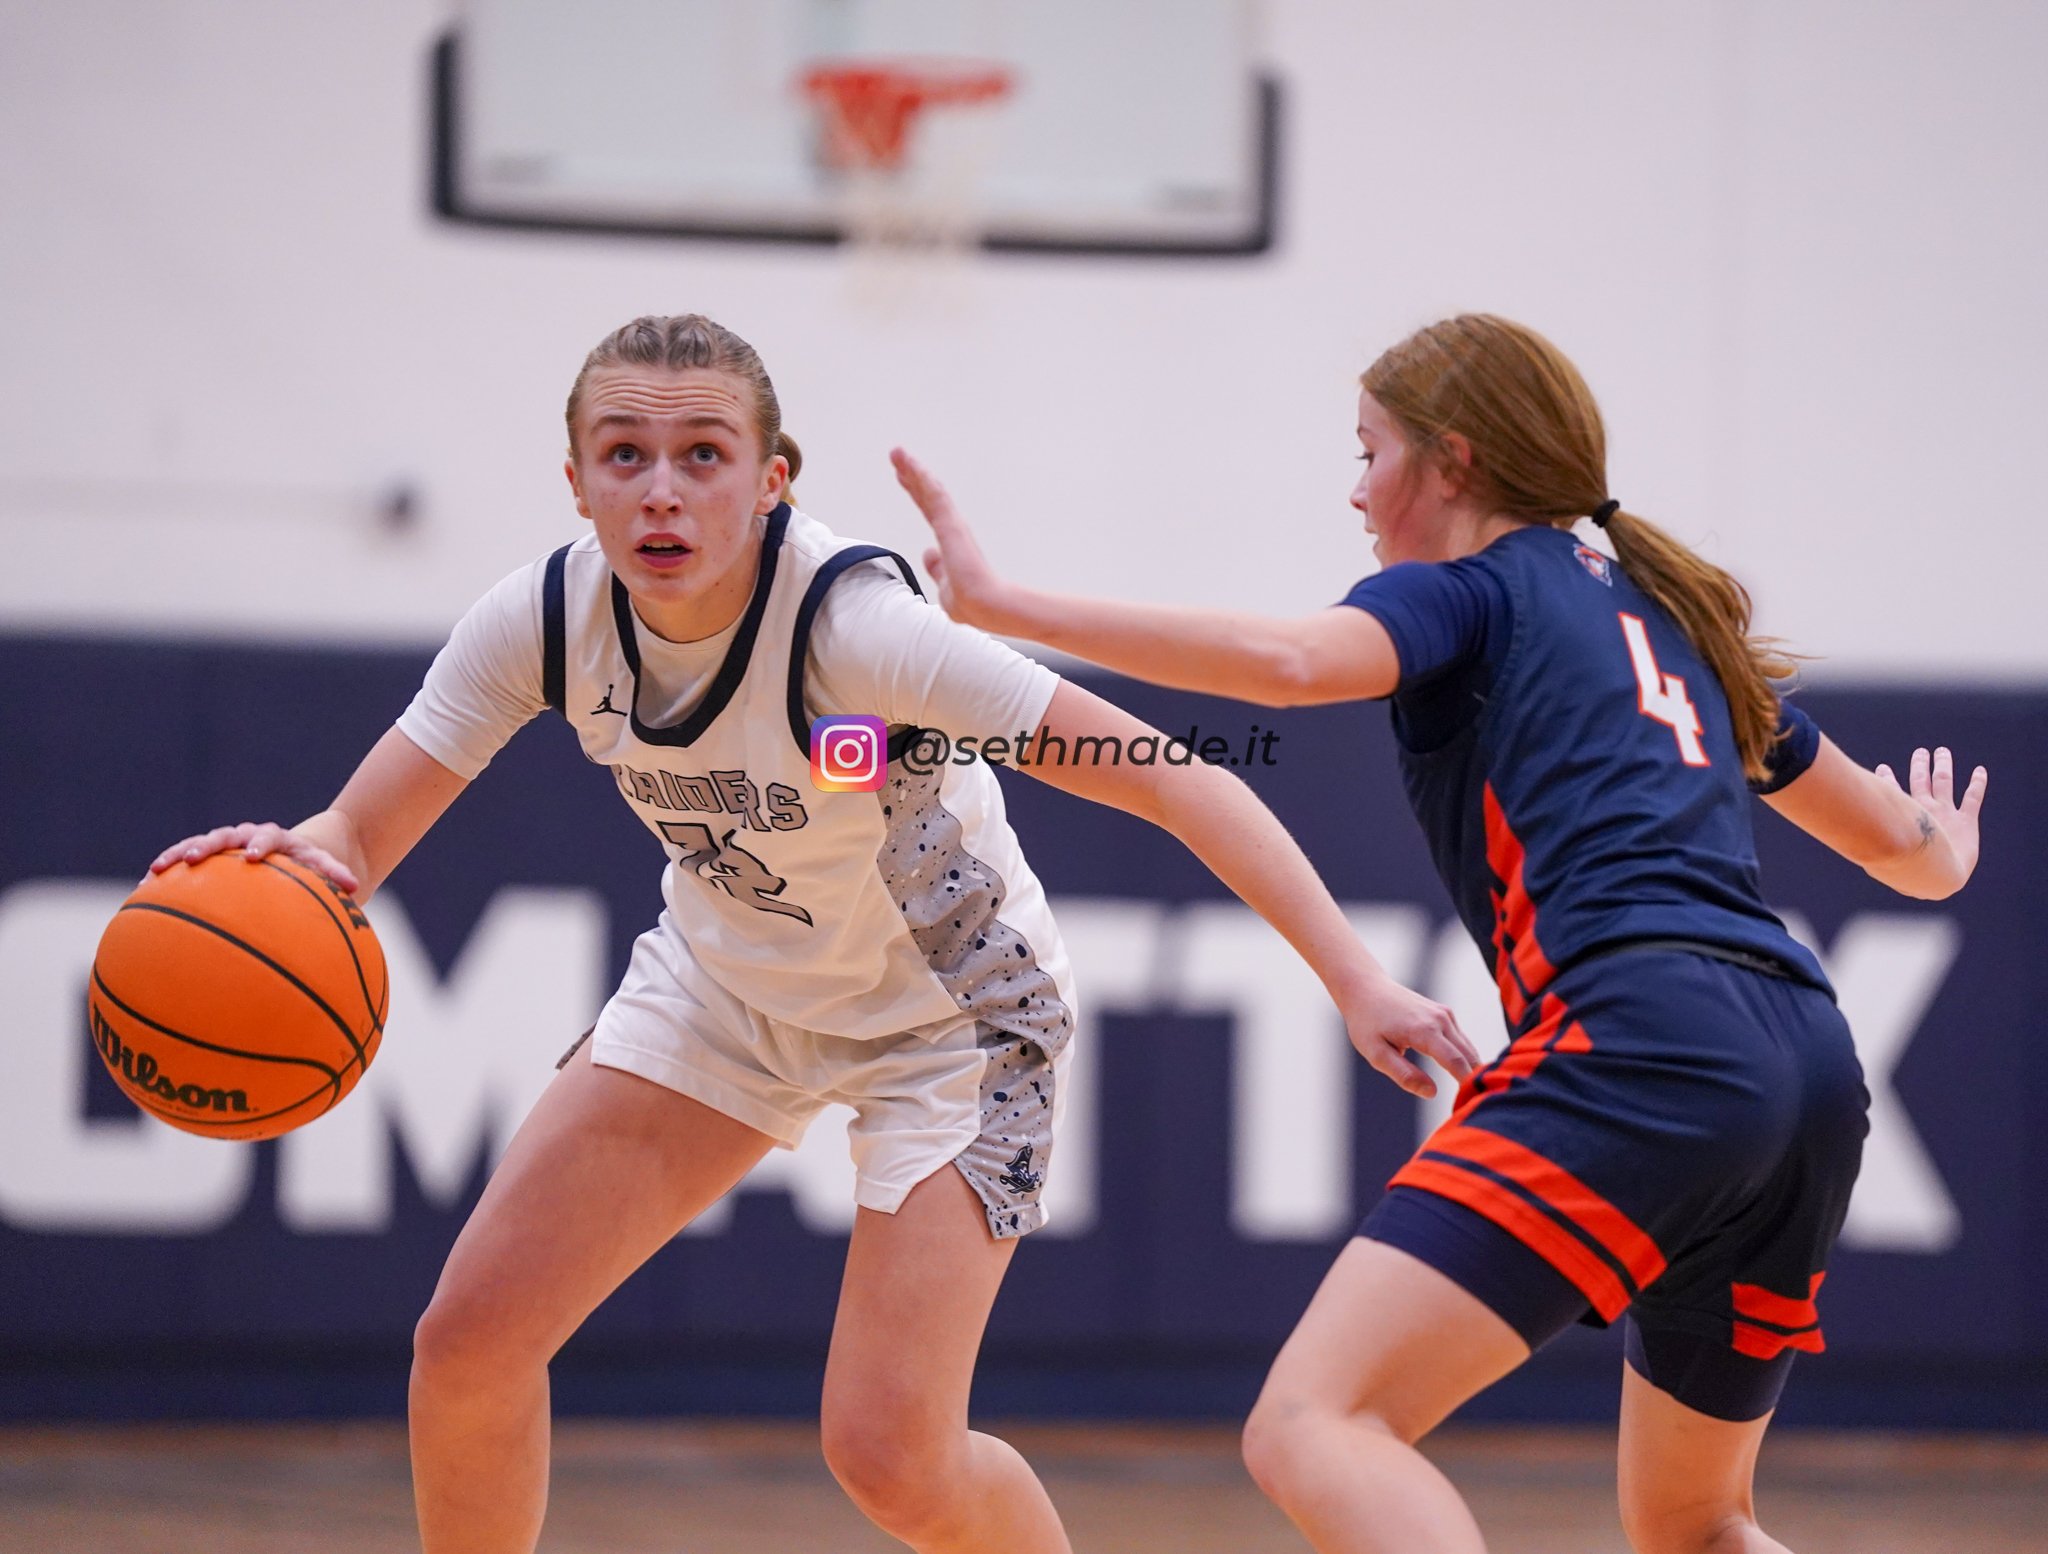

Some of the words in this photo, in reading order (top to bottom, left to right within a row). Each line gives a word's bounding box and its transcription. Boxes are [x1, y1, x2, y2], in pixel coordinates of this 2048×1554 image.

[1617, 611, 1711, 768] 4
[611, 764, 809, 832] AIDERS
[94, 1000, 250, 1113] Wilson
